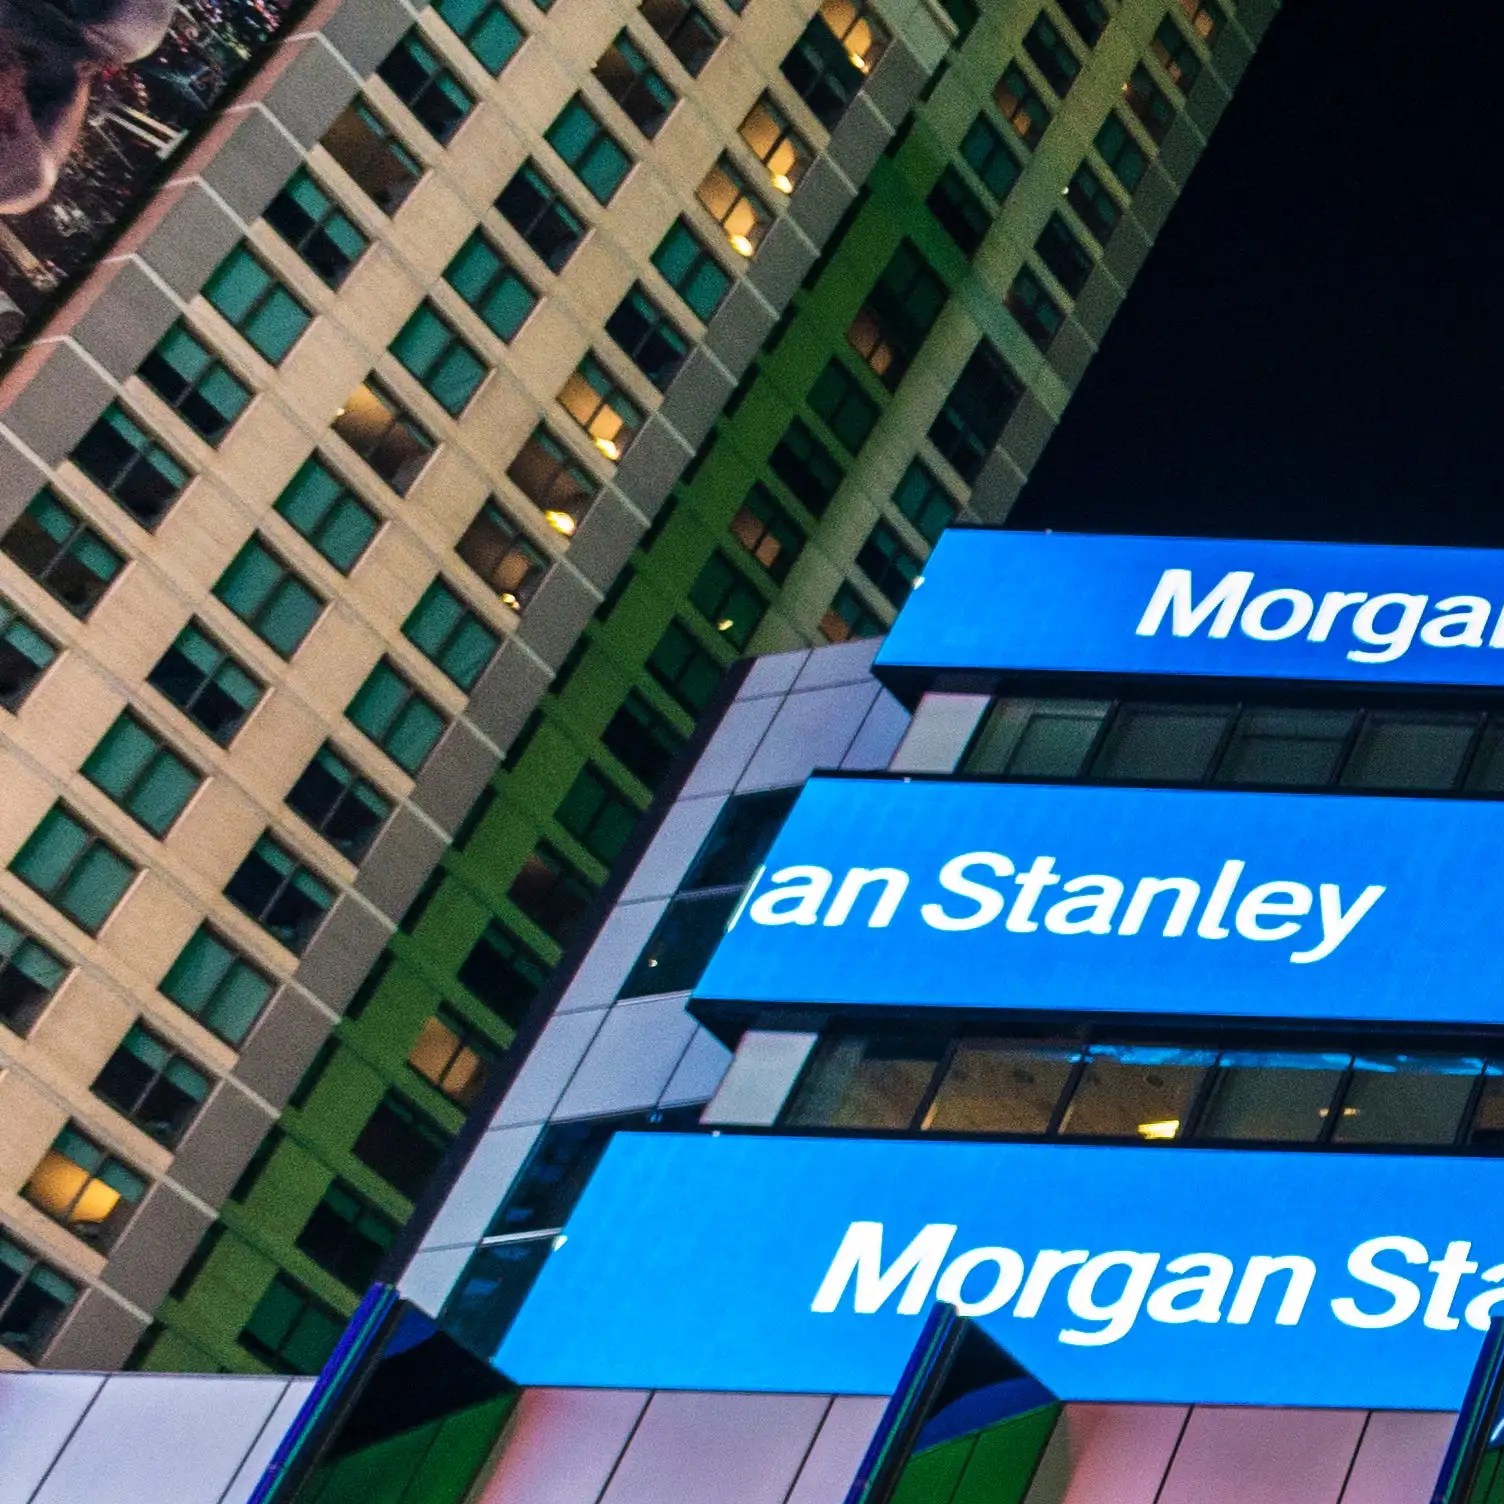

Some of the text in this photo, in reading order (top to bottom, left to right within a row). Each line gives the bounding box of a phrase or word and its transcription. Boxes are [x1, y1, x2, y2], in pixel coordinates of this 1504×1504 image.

[728, 852, 1385, 963] an Stanley
[812, 1222, 1316, 1345] Morgan
